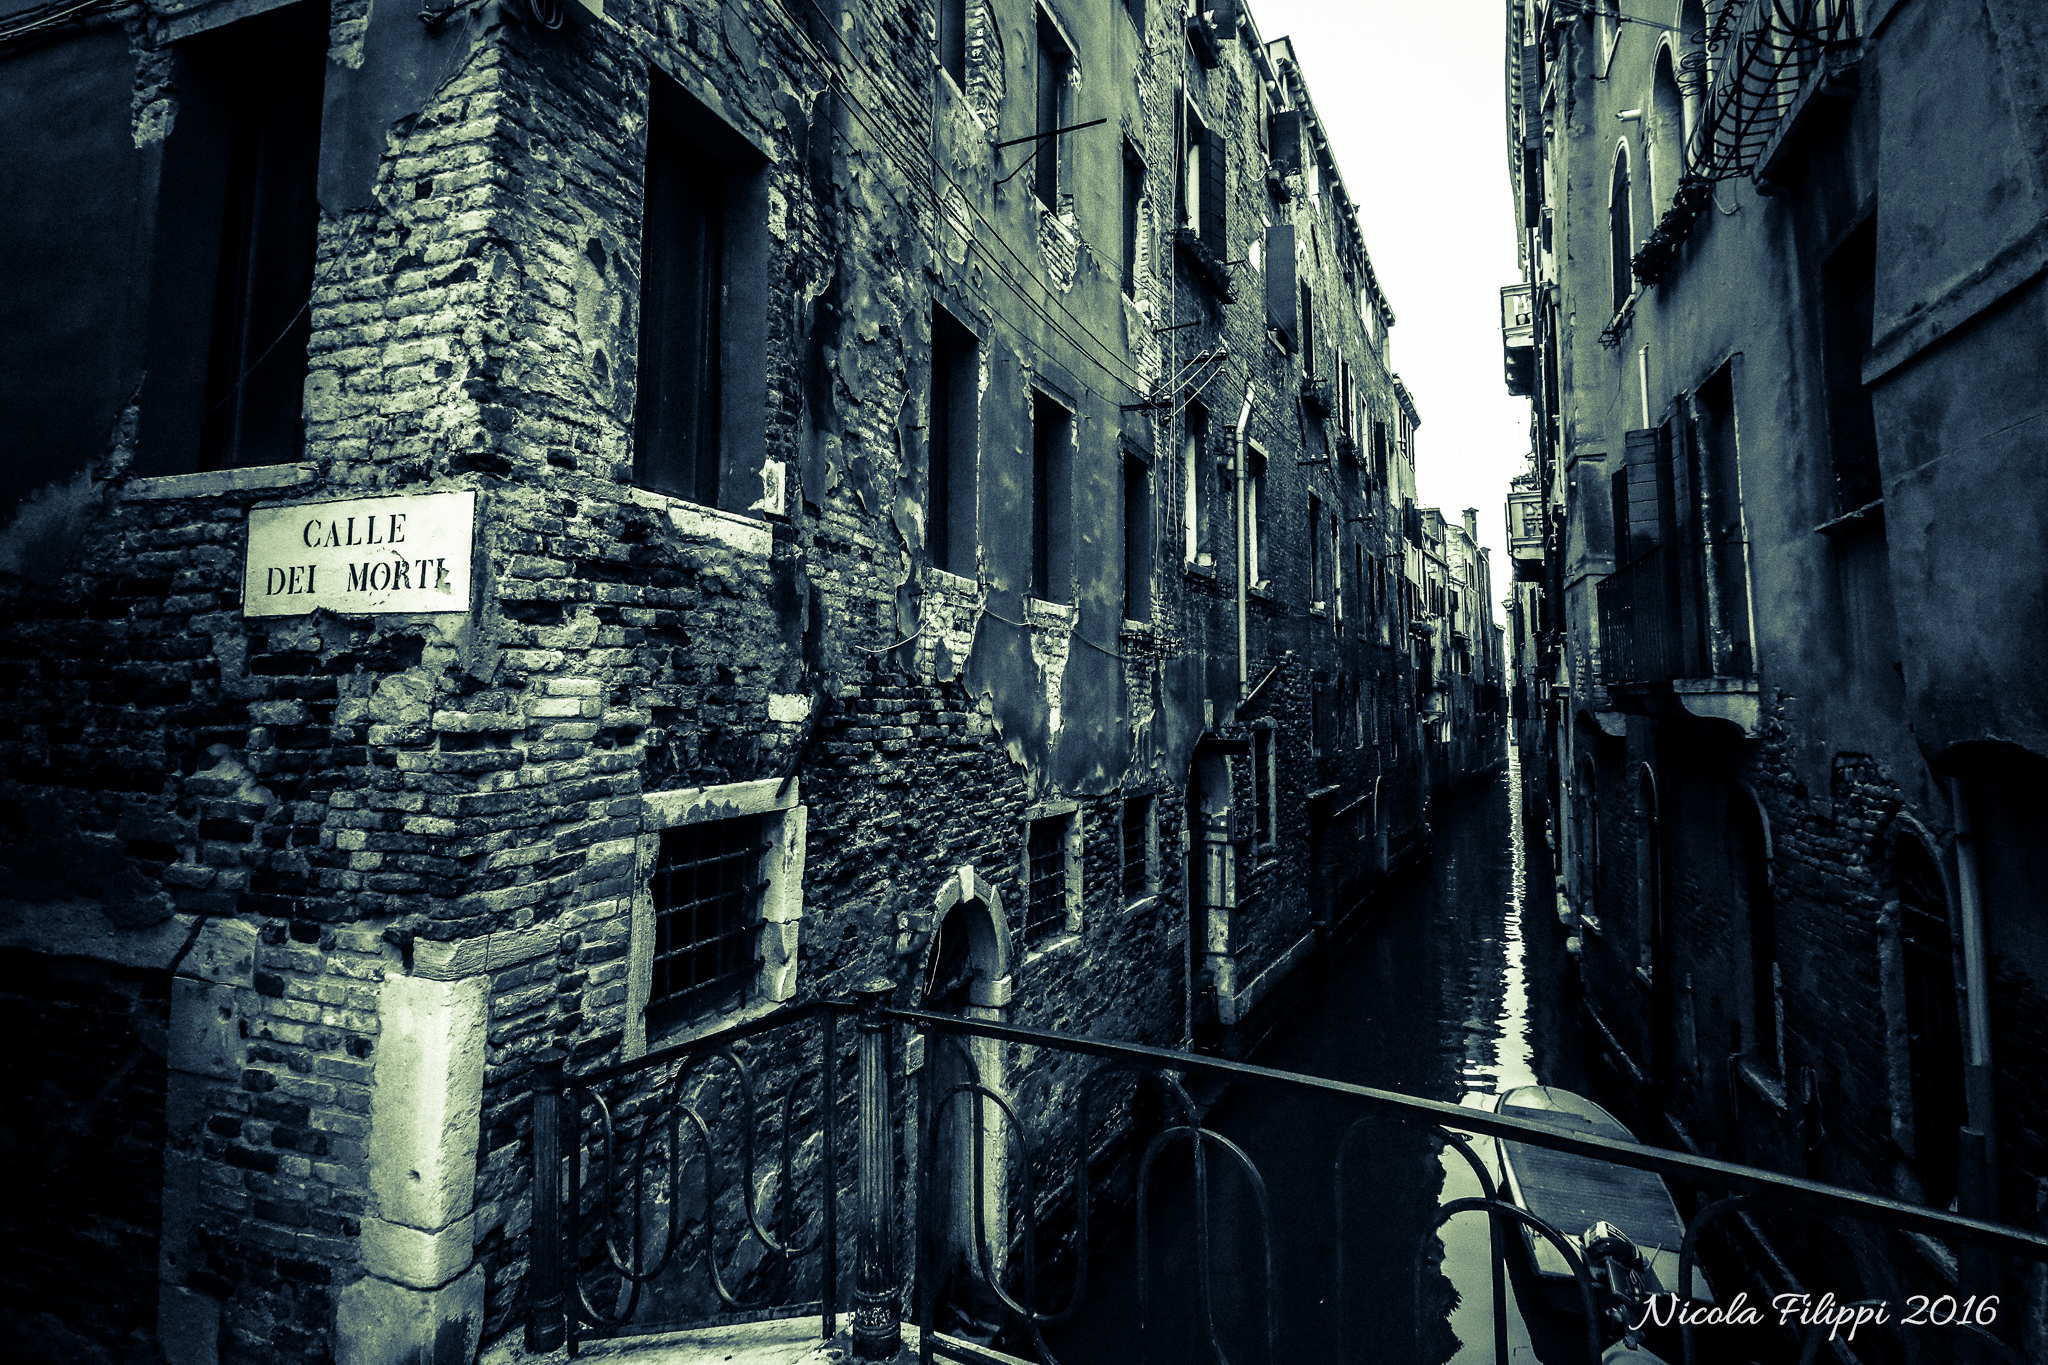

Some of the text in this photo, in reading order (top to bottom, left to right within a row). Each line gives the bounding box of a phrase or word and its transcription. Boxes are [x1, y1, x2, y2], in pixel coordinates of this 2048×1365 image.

[303, 514, 406, 548] CALLE
[266, 558, 446, 596] DEI MORTI
